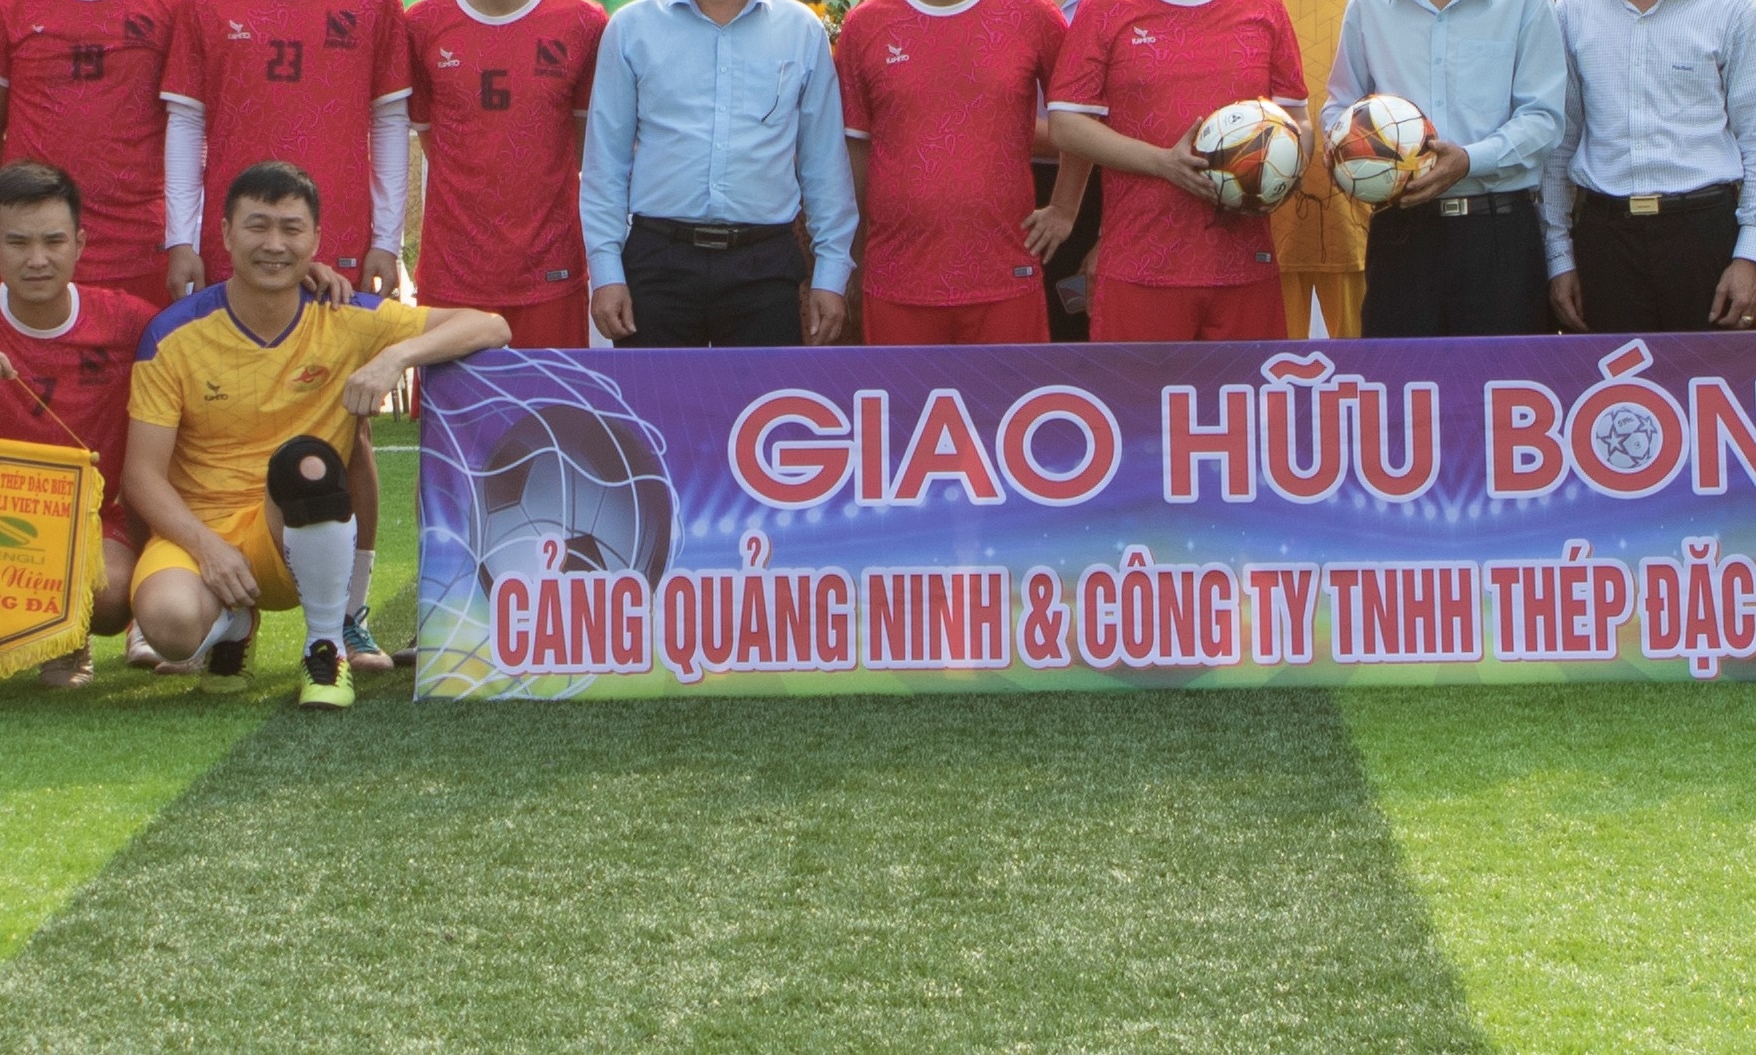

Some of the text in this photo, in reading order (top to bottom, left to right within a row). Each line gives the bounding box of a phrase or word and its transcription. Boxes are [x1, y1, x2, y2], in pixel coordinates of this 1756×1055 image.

[480, 69, 511, 111] 6
[729, 388, 1120, 505] GIAO
[1163, 352, 1439, 503] HỮU
[43, 500, 72, 518] NAM
[25, 596, 60, 614] ĐÁ
[493, 537, 649, 671] CẢNG
[660, 533, 853, 680] QUẢNG
[869, 564, 1010, 669] NINH
[1020, 569, 1068, 667] &
[1077, 547, 1239, 665] CÔNG
[1249, 563, 1320, 661] TY
[1326, 562, 1481, 661] TNHH
[1490, 542, 1631, 658] THÉP
